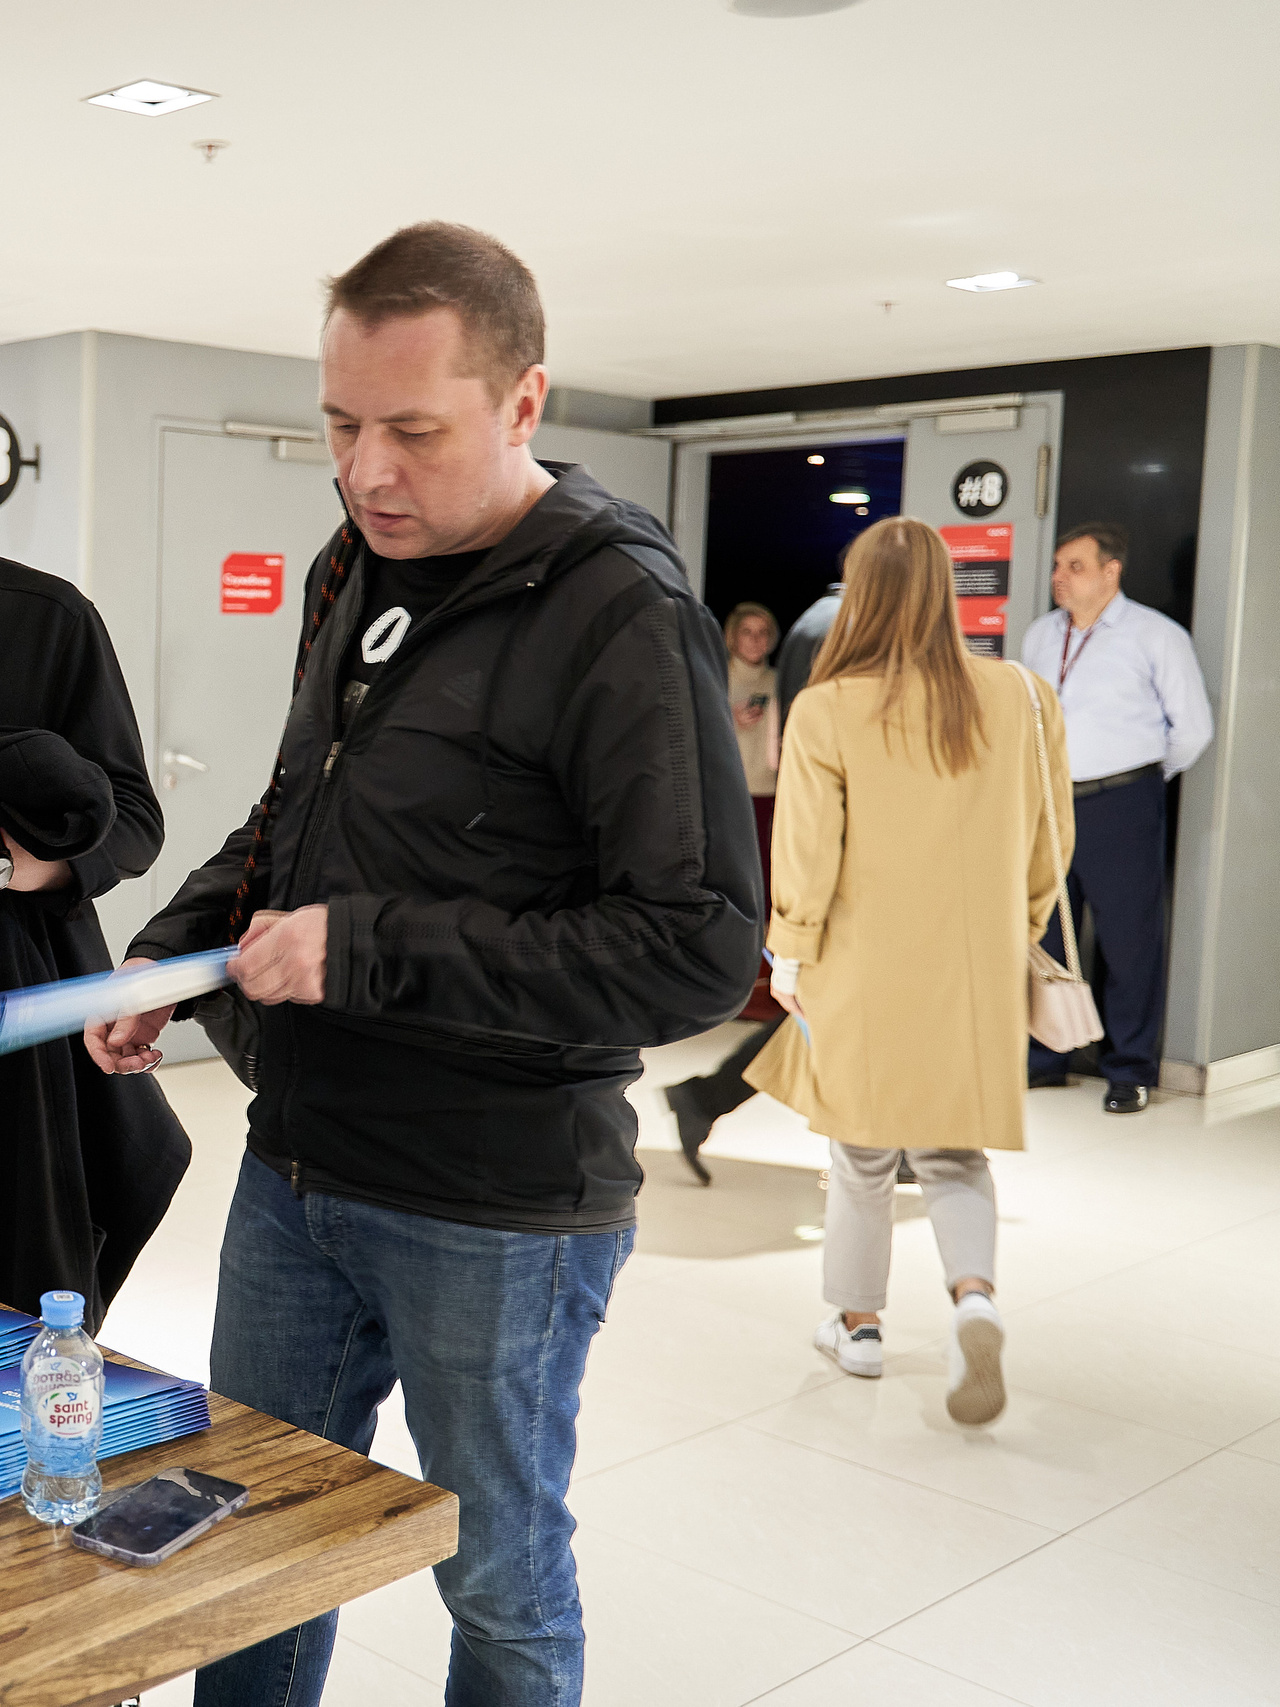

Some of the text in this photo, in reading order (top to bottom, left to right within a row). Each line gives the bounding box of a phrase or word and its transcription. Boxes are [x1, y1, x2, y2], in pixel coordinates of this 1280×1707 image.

[958, 471, 1004, 507] #8
[54, 1400, 89, 1413] saint
[49, 1411, 93, 1428] spring
